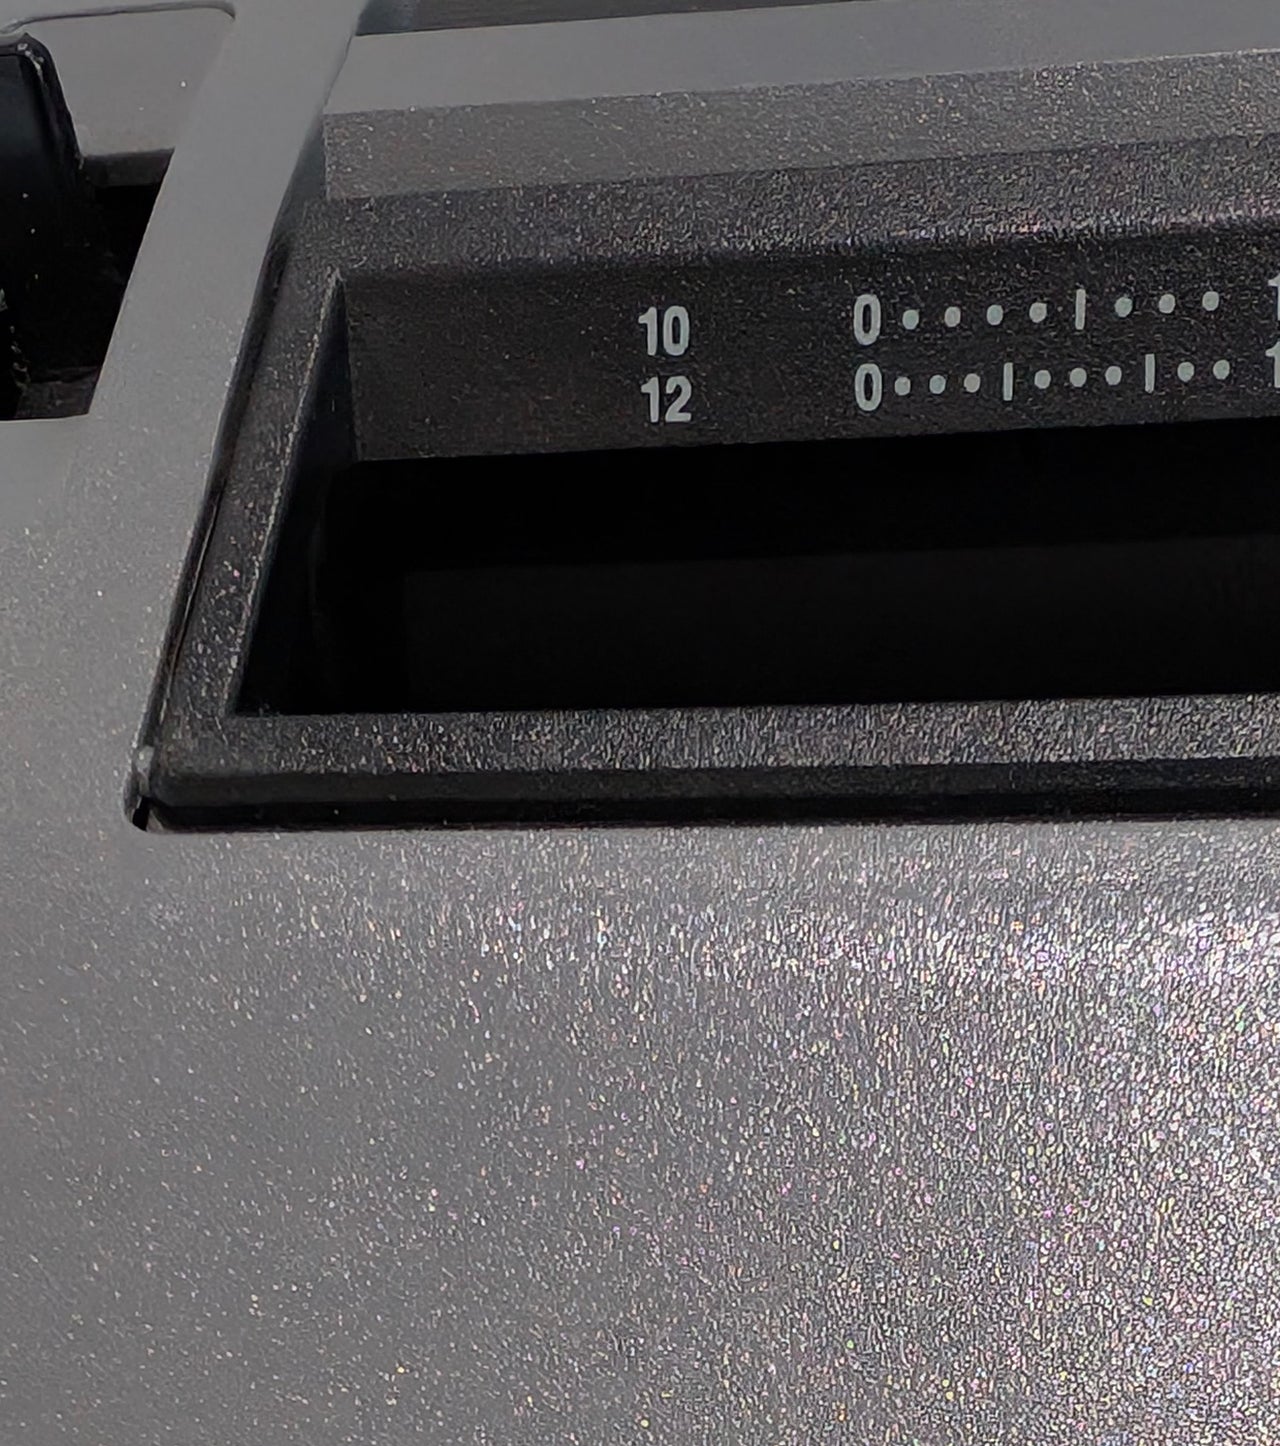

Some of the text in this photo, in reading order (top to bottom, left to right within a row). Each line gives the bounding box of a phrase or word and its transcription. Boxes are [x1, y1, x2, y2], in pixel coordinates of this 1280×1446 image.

[637, 305, 690, 356] 10
[852, 293, 882, 346] 0
[640, 375, 692, 423] 12
[854, 362, 883, 412] 0
